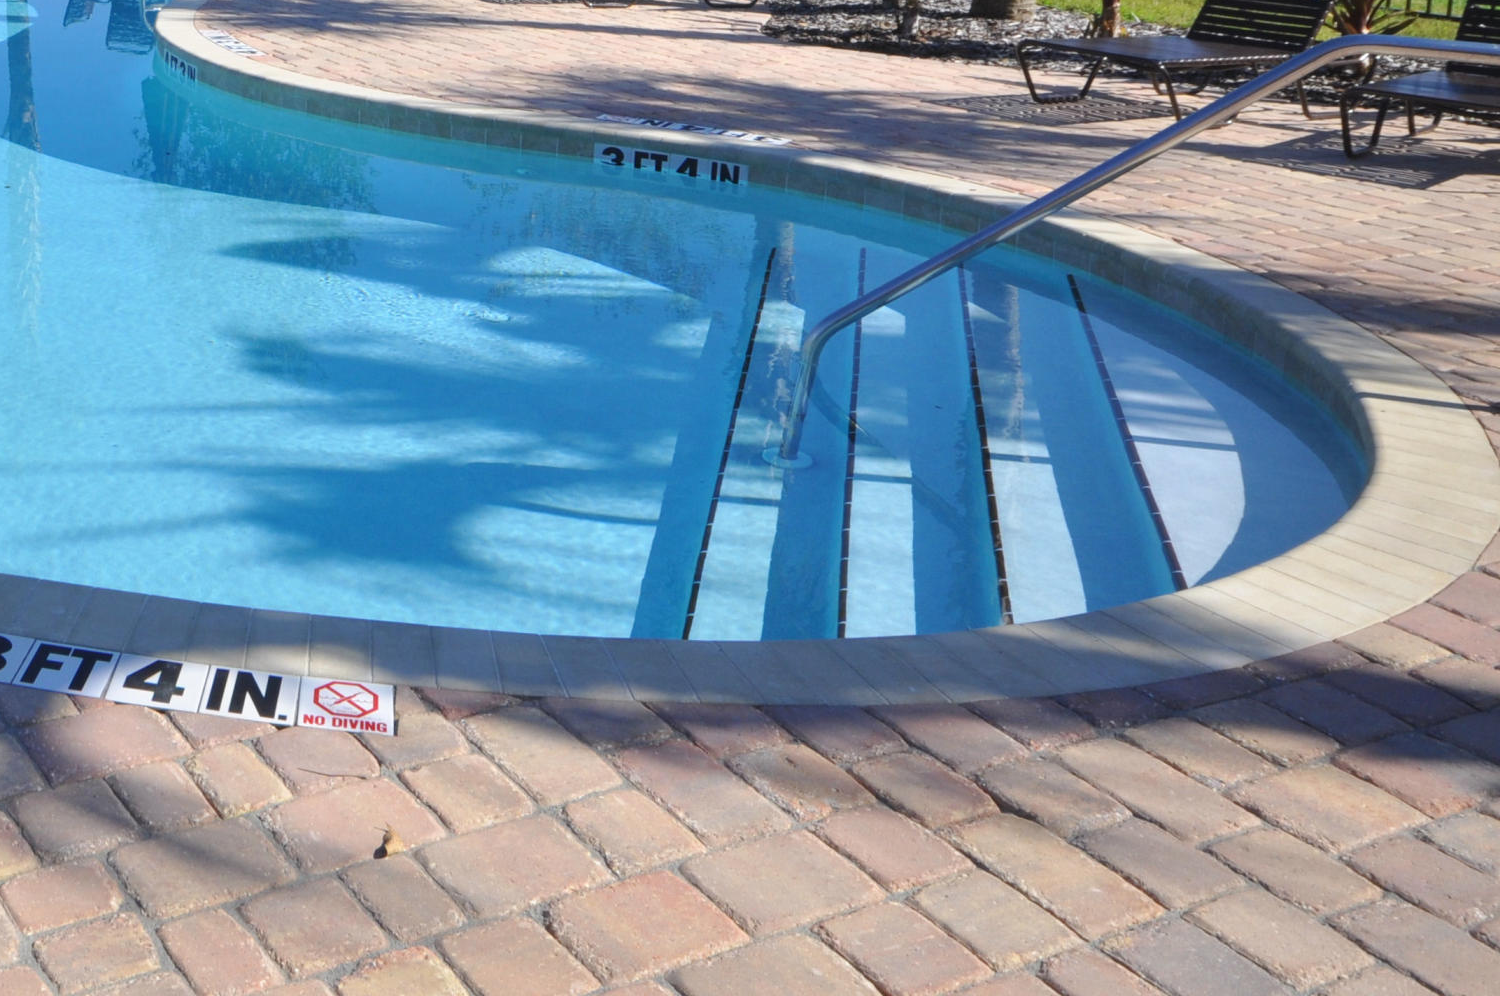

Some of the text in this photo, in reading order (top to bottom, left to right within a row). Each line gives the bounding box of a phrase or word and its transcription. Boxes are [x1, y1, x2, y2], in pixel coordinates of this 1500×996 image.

[602, 147, 740, 184] 3 FT 4 IN
[20, 643, 114, 691] FT
[122, 659, 185, 704] 4
[205, 667, 287, 720] IN.
[303, 714, 387, 732] NO DIVING
